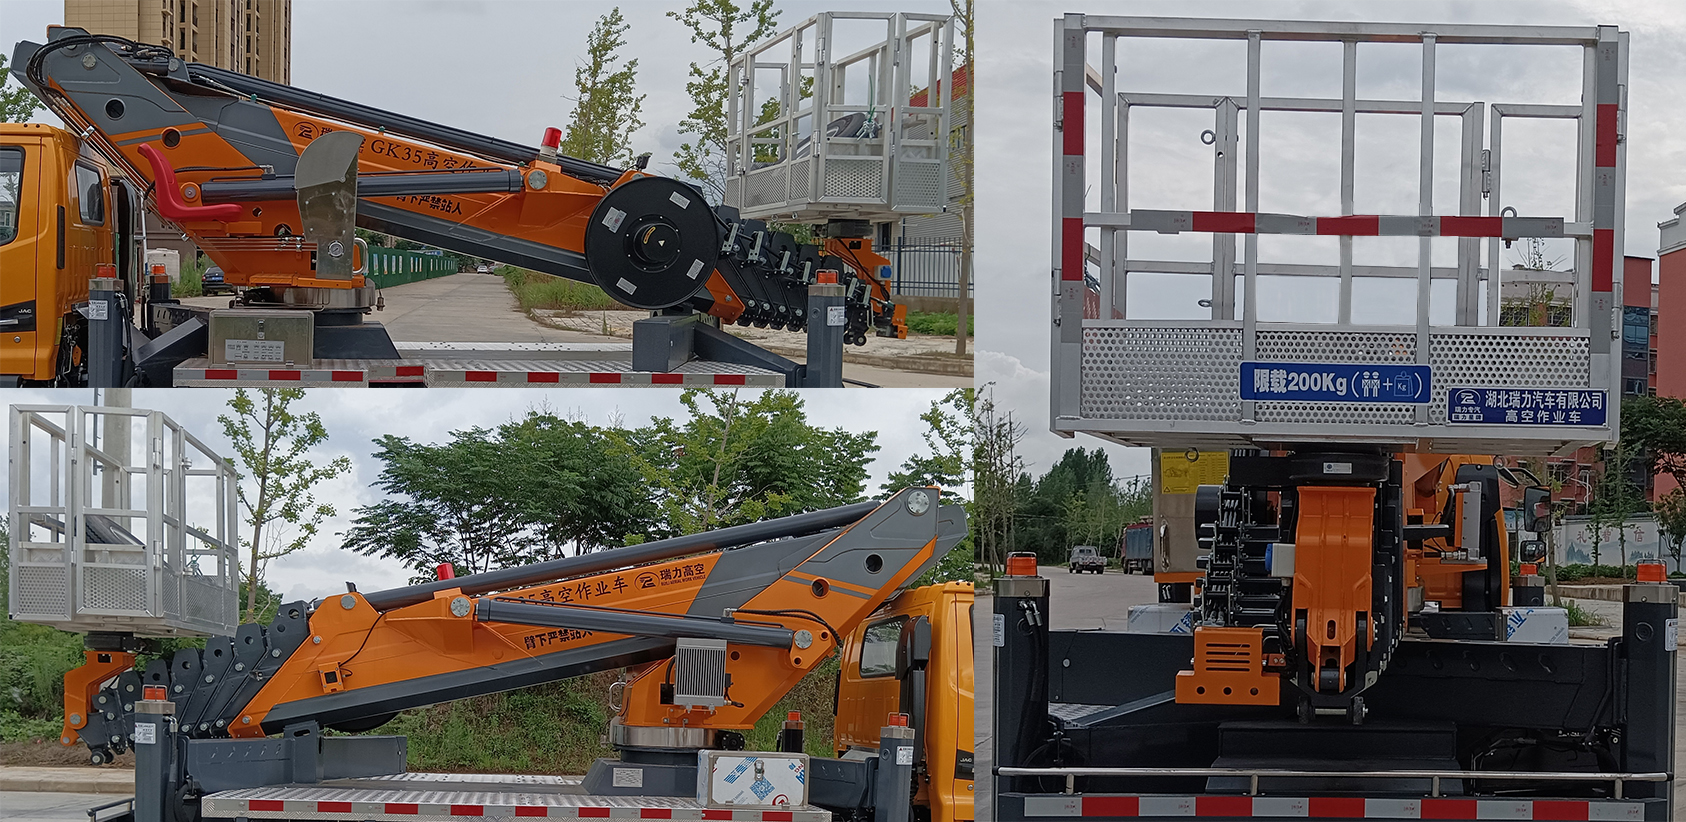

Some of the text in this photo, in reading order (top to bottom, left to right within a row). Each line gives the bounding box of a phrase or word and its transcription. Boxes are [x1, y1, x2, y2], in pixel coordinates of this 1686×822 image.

[1485, 390, 1603, 410] 湖北瑞力汽车有限公司
[1505, 409, 1582, 423] 高空作业车
[1633, 529, 1644, 542] 信
[660, 563, 705, 581] 瑞力高空
